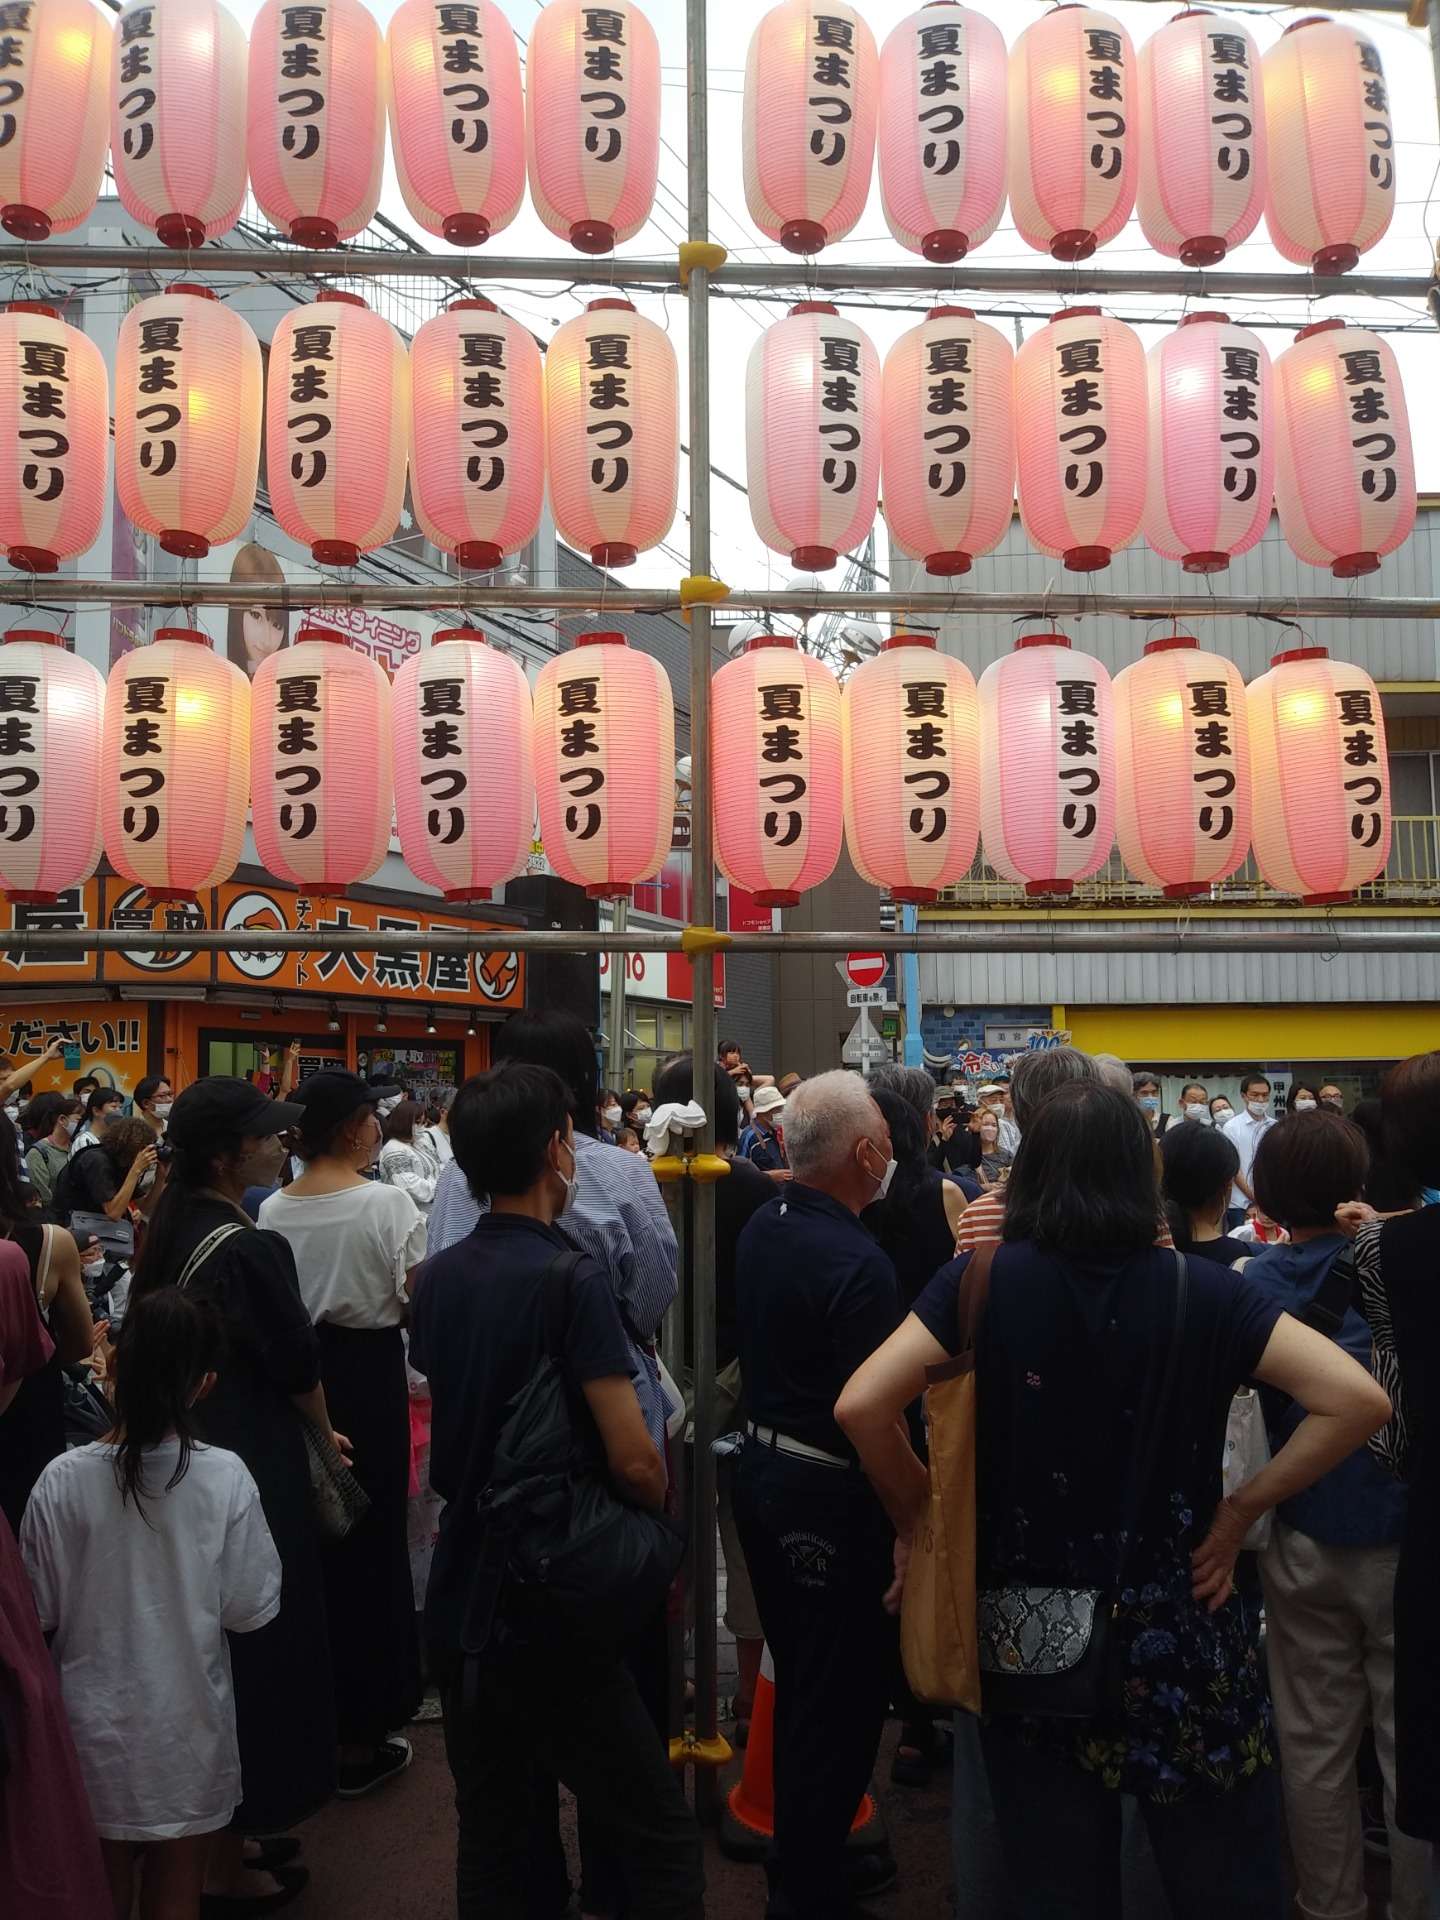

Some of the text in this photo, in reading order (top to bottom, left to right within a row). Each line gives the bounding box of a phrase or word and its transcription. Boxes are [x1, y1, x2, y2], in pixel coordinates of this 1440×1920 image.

[119, 3, 156, 160] 夏まつり
[278, 7, 326, 159] 夏まつり
[436, 4, 489, 153] 夏まつり
[581, 9, 626, 162] 夏まつり
[809, 17, 853, 166] 夏まつり
[918, 24, 964, 175] 夏まつり
[1084, 30, 1126, 179] 夏まつり
[1208, 34, 1252, 181] 夏まつり
[1356, 41, 1393, 190] 夏まつり
[19, 341, 69, 501] 夏まつり
[136, 317, 183, 476] 夏まつり
[288, 326, 336, 487] 夏まつり
[459, 334, 508, 491] 夏まつり
[586, 334, 633, 493] 夏まつり
[820, 338, 861, 494] 夏まつり
[924, 339, 971, 497] 夏まつり
[1056, 339, 1107, 498] 夏まつり
[1220, 347, 1260, 502] 夏まつり
[1339, 350, 1396, 502] 夏まつり
[0, 676, 40, 842] 夏まつり
[120, 677, 169, 842] 夏まつり
[276, 676, 321, 839] 夏まつり
[420, 679, 467, 844] 夏まつり
[558, 677, 604, 840] 夏まつり
[758, 684, 806, 846] 夏まつり
[903, 682, 950, 842] 夏まつり
[1056, 681, 1100, 838] 夏まつり
[1187, 681, 1235, 840] 夏まつり
[1336, 690, 1383, 847] 夏まつり
[850, 992, 884, 1004] 自転車を除く
